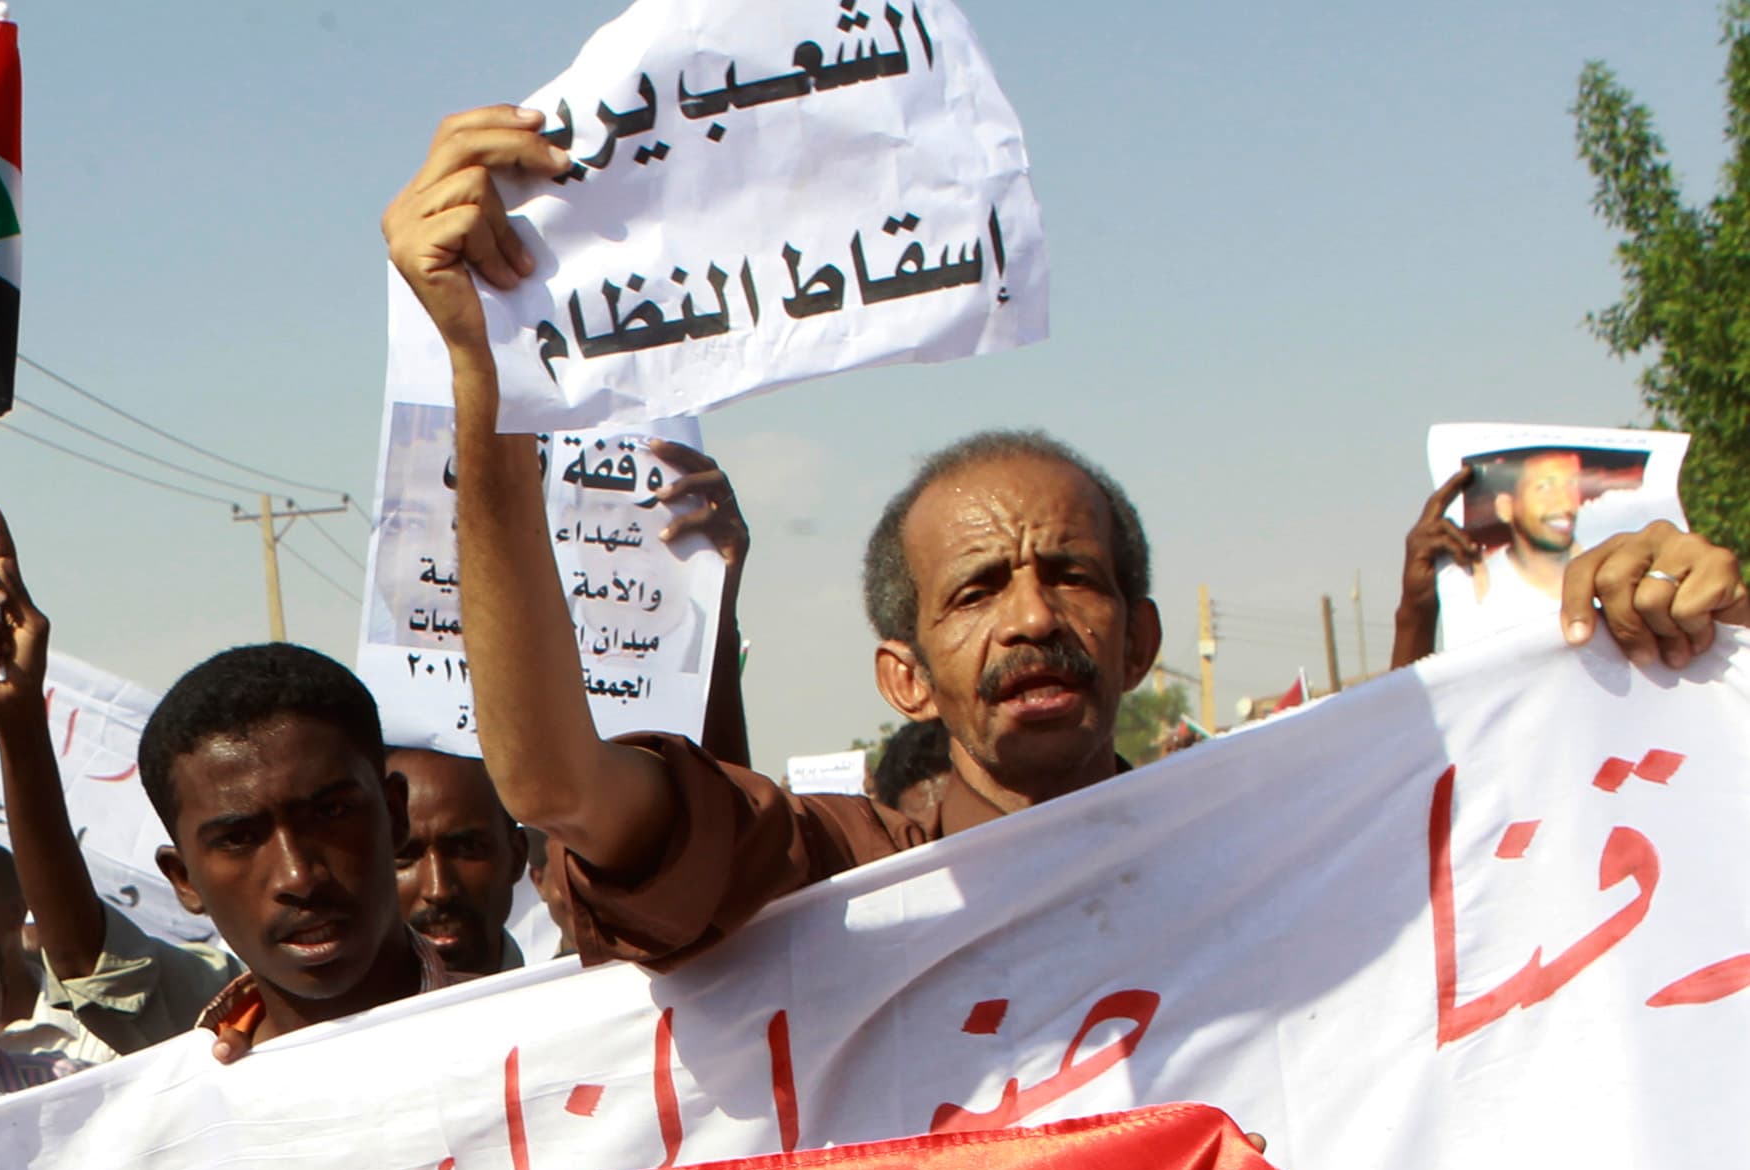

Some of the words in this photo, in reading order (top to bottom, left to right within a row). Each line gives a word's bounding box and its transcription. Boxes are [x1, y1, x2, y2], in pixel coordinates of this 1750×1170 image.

[678, 0, 935, 142] الشعب
[539, 71, 671, 186] يري
[781, 203, 1008, 320] إسقاط
[536, 254, 761, 386] النظام
[562, 435, 664, 509] وقفة
[555, 522, 643, 553] شهداء
[409, 608, 464, 644] مبات
[592, 626, 660, 659] ميدان
